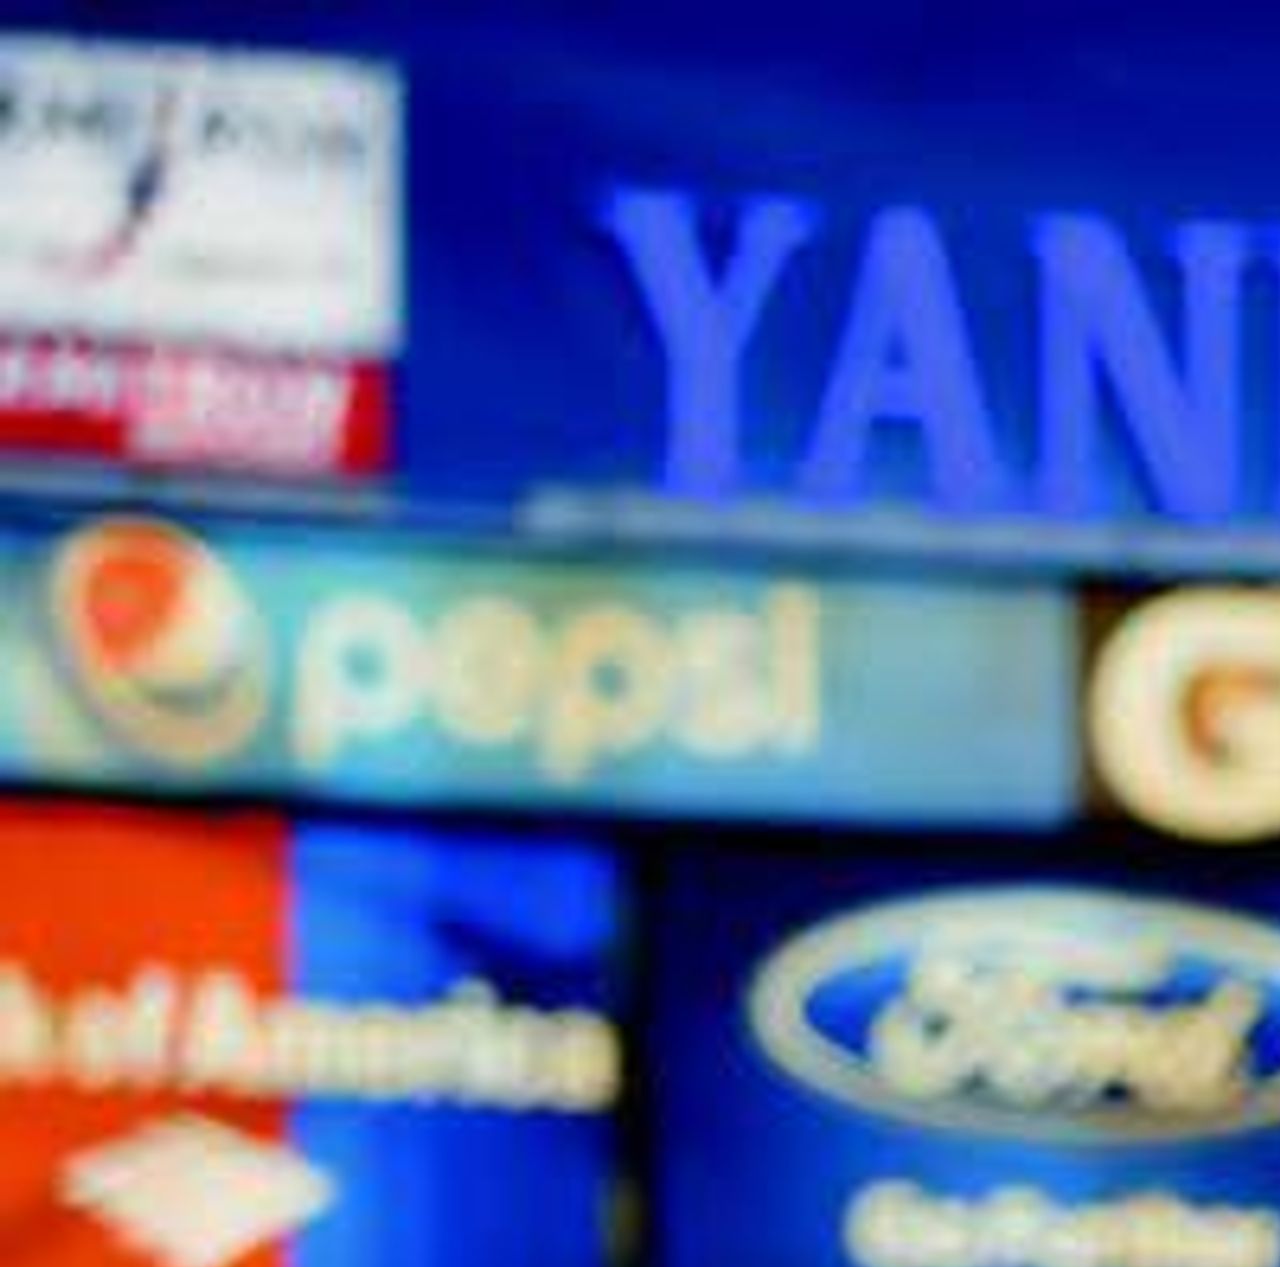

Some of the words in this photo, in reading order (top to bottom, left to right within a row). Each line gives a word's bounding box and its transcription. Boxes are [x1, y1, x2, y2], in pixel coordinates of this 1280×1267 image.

[290, 578, 822, 786] pepsi
[182, 966, 623, 1113] America
[868, 905, 1262, 1112] Ford
